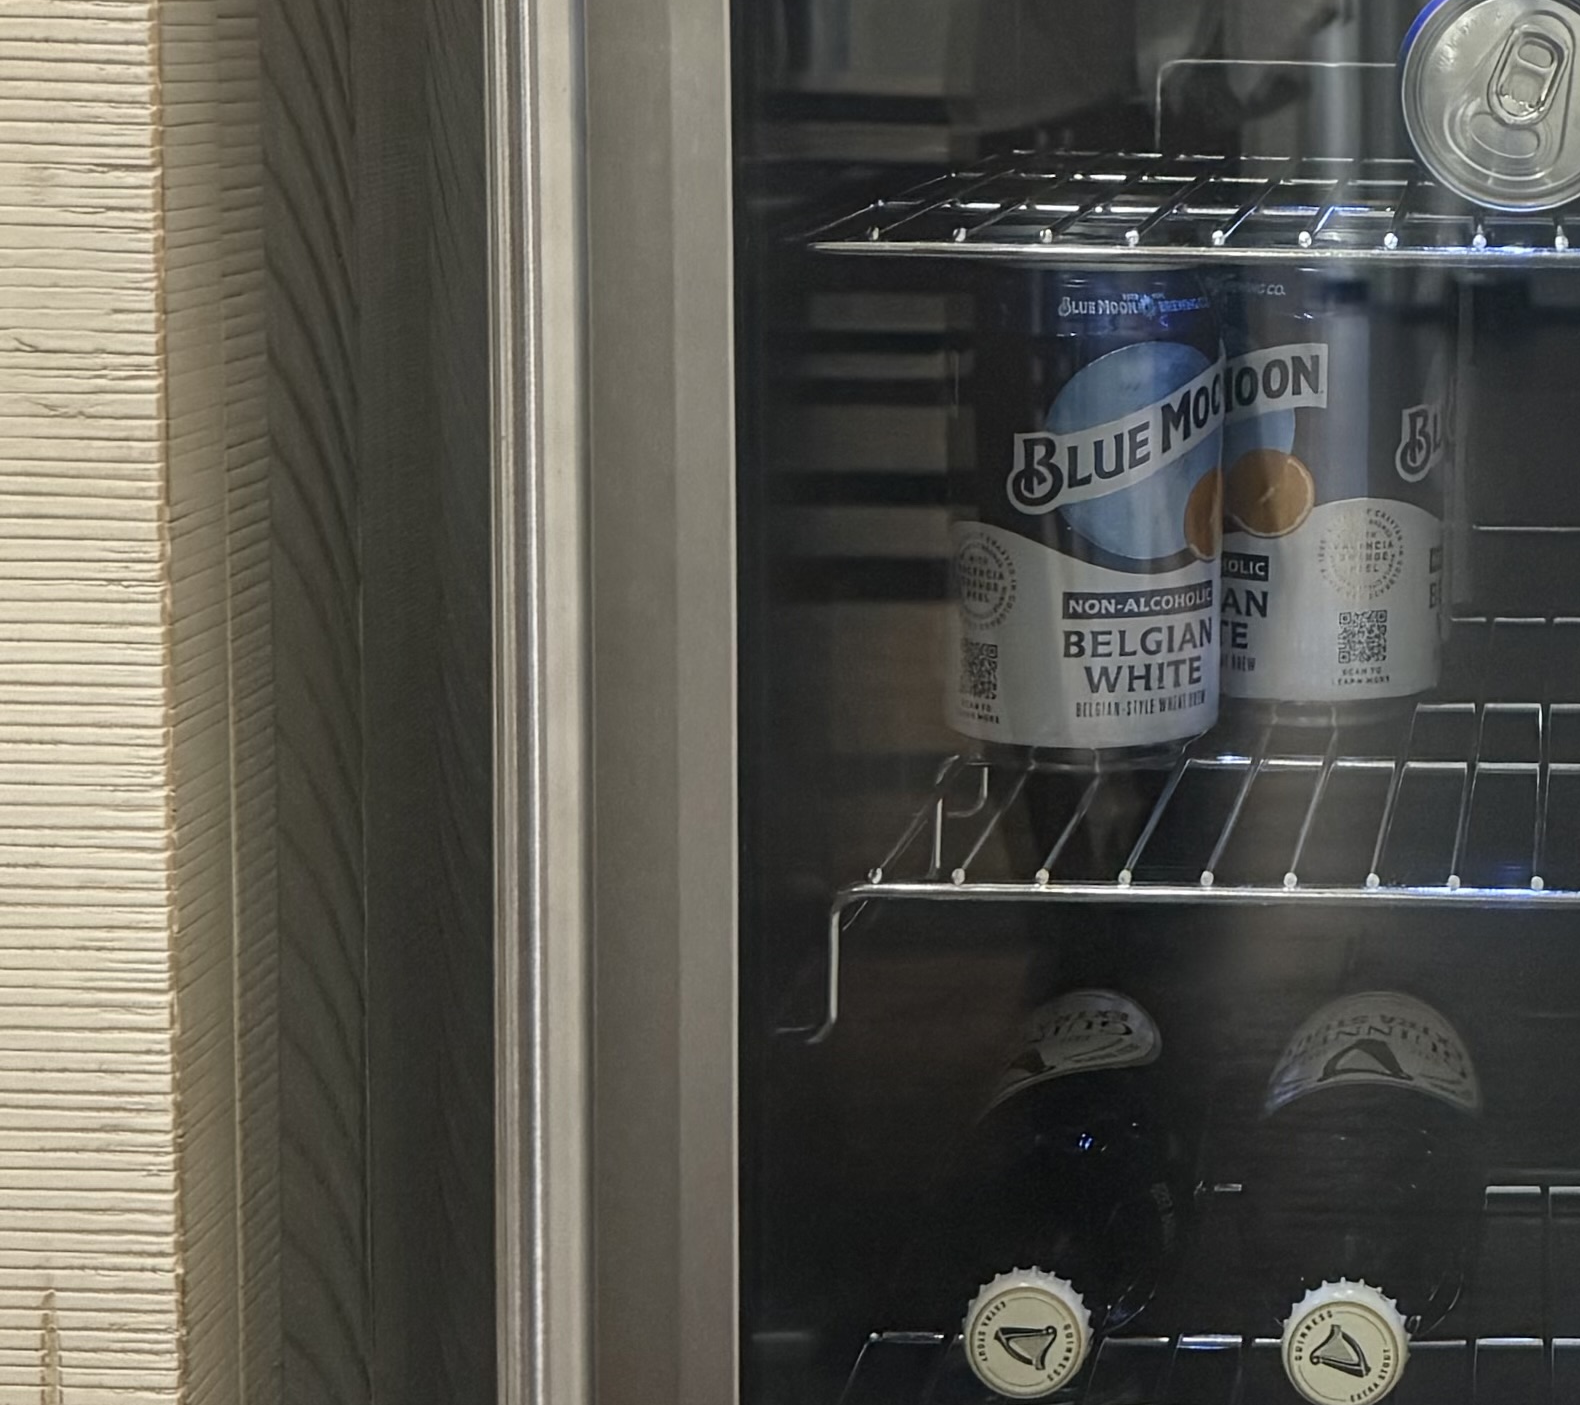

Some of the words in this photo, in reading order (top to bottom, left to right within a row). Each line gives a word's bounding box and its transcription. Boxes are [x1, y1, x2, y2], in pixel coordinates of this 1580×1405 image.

[1058, 297, 1095, 317] BLUE
[1098, 299, 1138, 315] MOON
[1012, 421, 1152, 507] BLUE
[1160, 372, 1221, 455] MOO
[1069, 588, 1213, 614] NON-ALCOHOLIC
[1062, 617, 1213, 659] BELGIAN
[1083, 655, 1202, 694] WHITE
[1047, 1323, 1075, 1382] GUINNESS
[1294, 1310, 1334, 1362] GUINNESS
